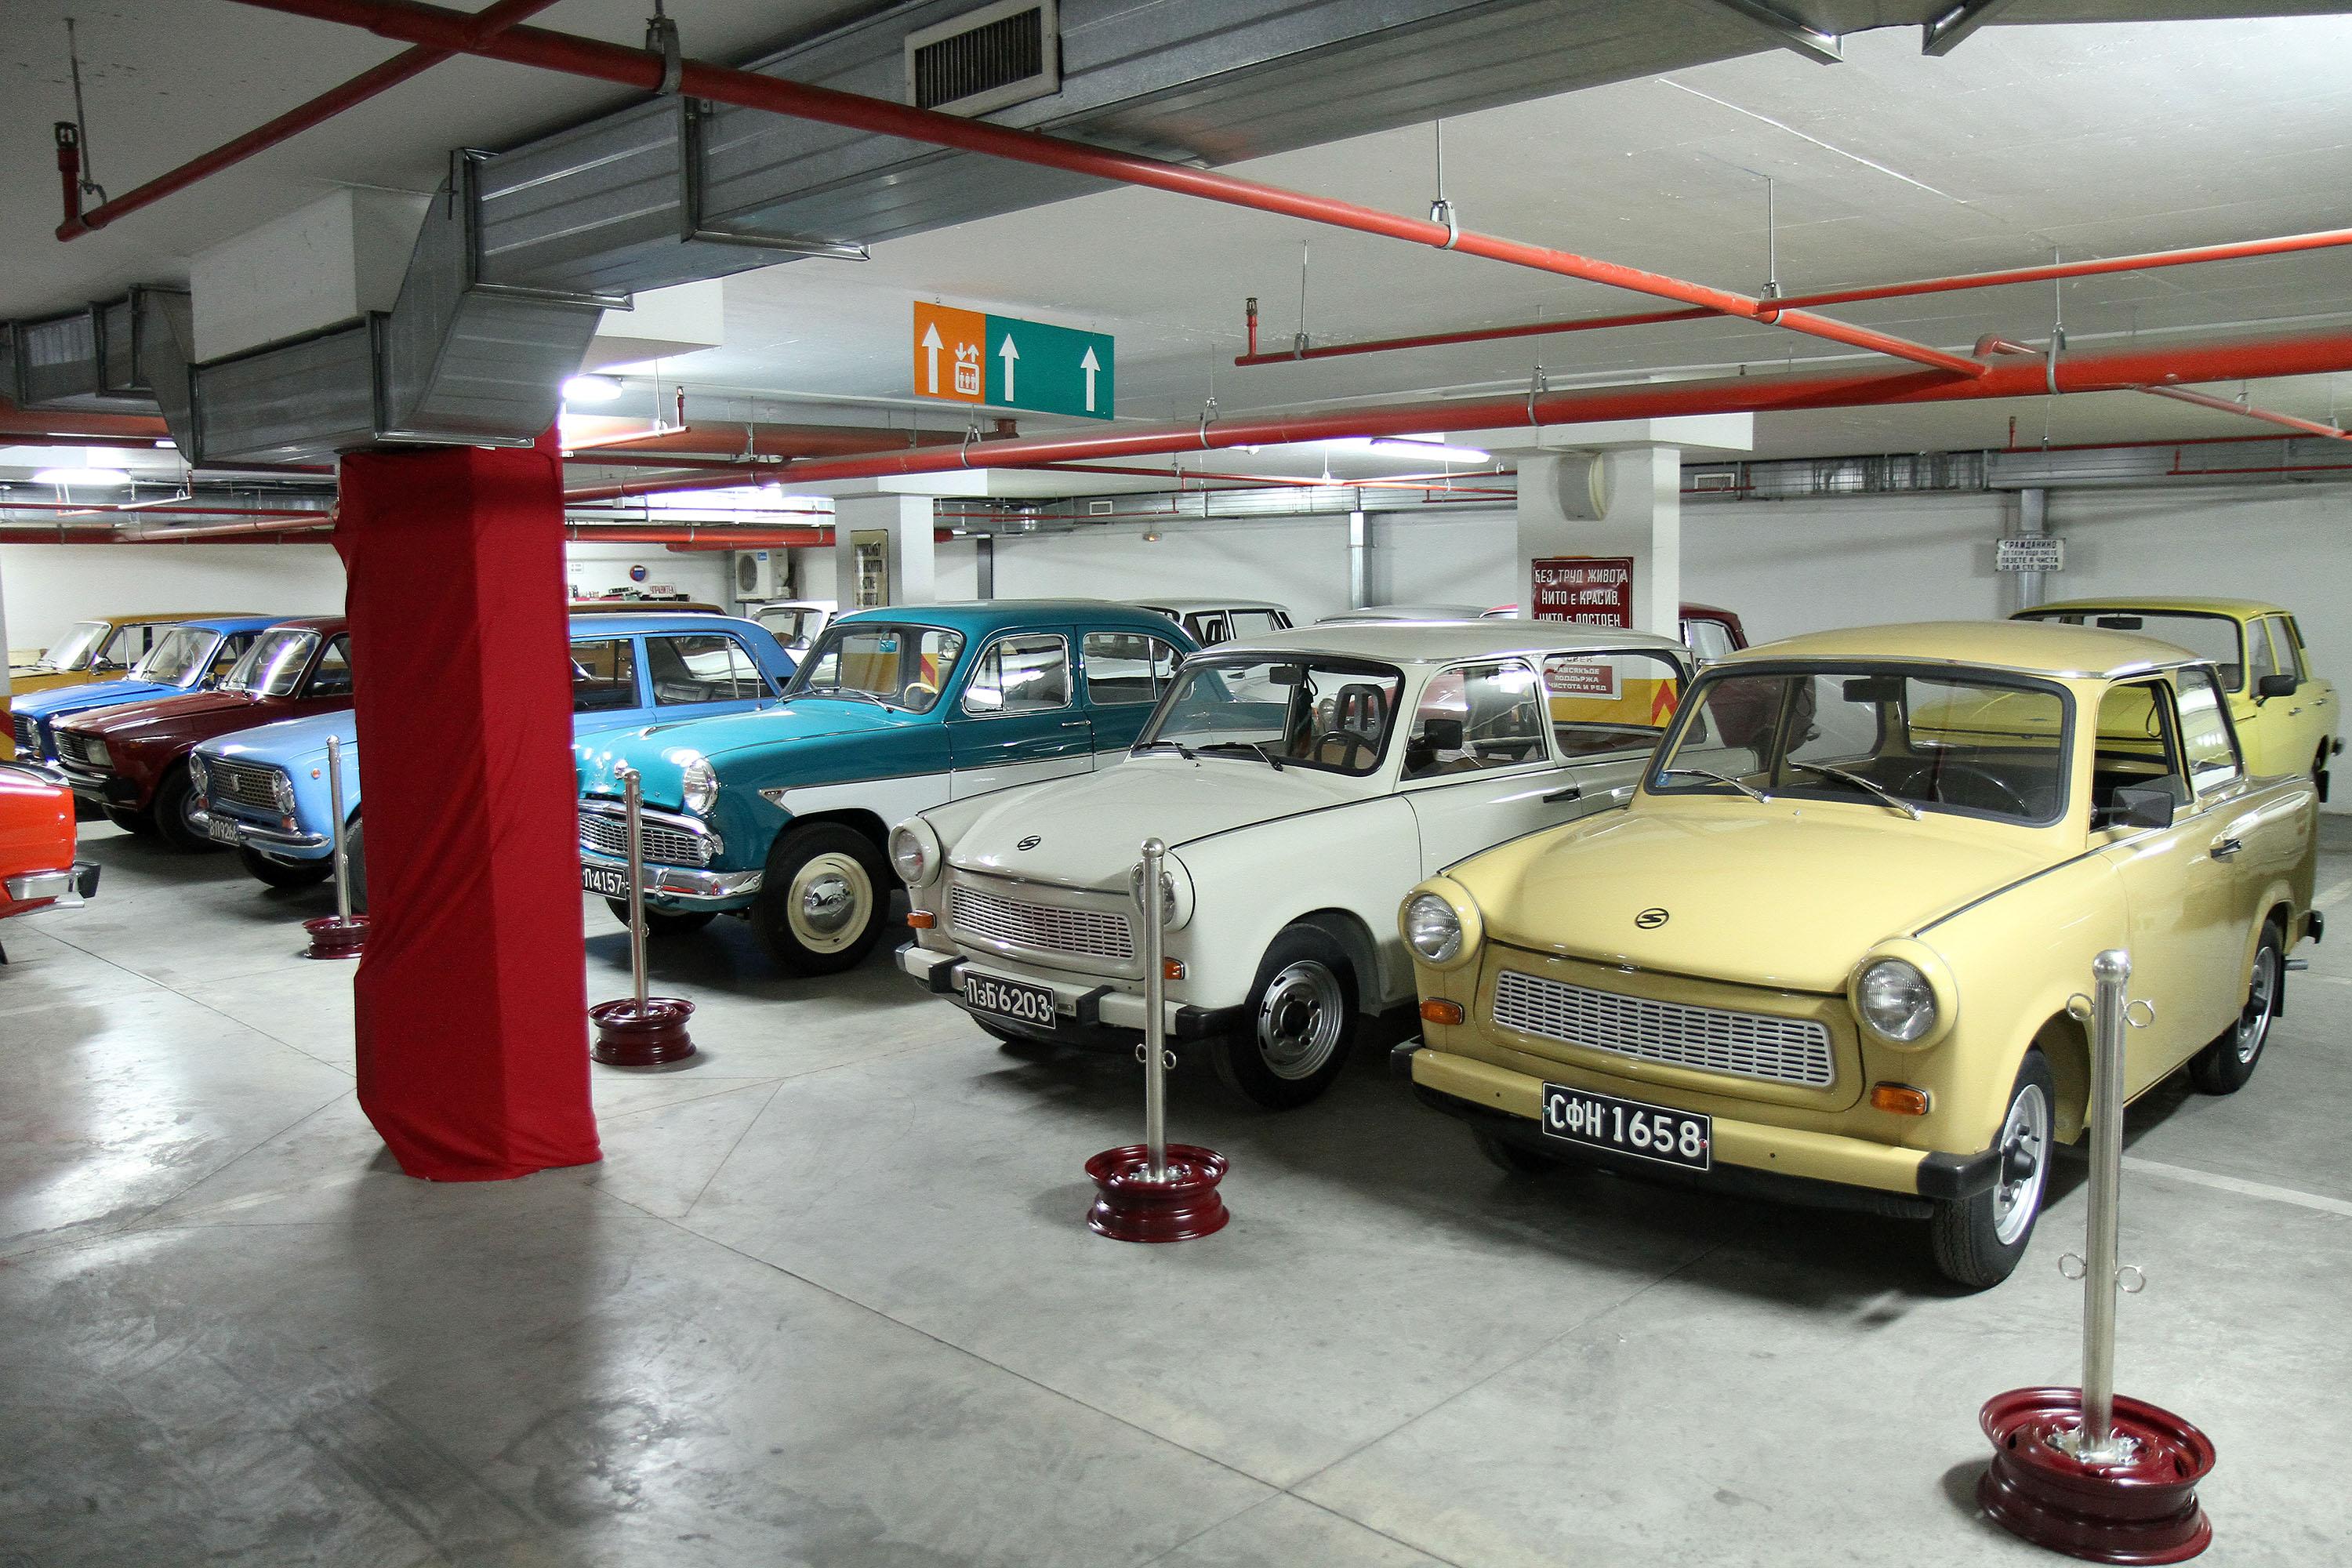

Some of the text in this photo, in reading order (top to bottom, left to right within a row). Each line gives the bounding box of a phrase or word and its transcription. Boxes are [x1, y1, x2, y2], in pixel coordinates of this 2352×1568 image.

[1534, 569, 1628, 585] БЕЗ ТРУД ЖИВОТА
[1541, 590, 1566, 605] НИТО
[1580, 590, 1621, 607] КРАСИВ,
[585, 868, 622, 895] П4157
